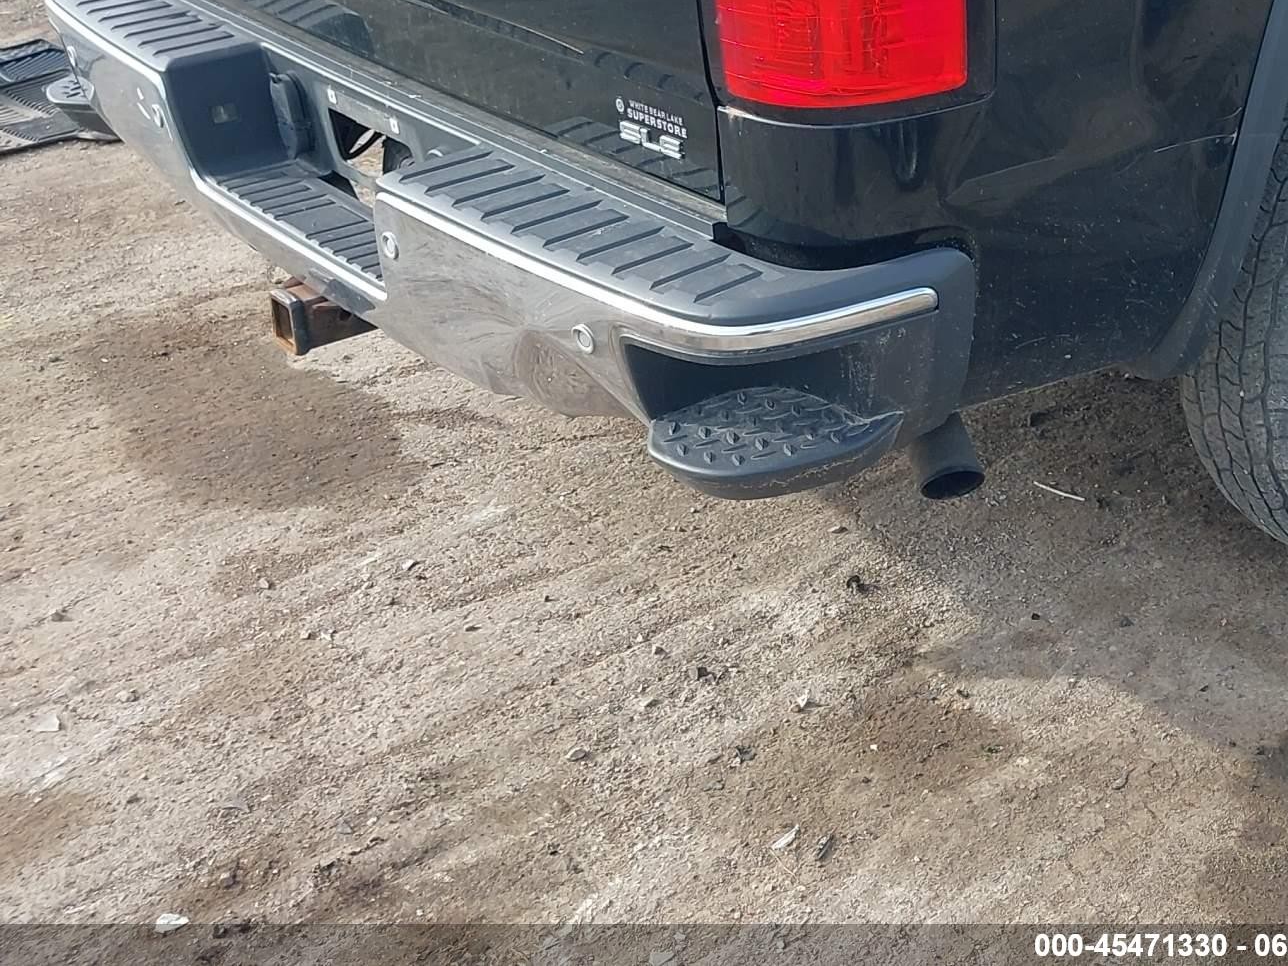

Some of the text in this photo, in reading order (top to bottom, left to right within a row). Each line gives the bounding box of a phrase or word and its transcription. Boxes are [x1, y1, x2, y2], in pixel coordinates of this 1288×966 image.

[627, 107, 688, 139] SUPERSTORE
[628, 99, 649, 114] WHITE
[666, 113, 683, 126] LAKE
[619, 121, 685, 160] SLE
